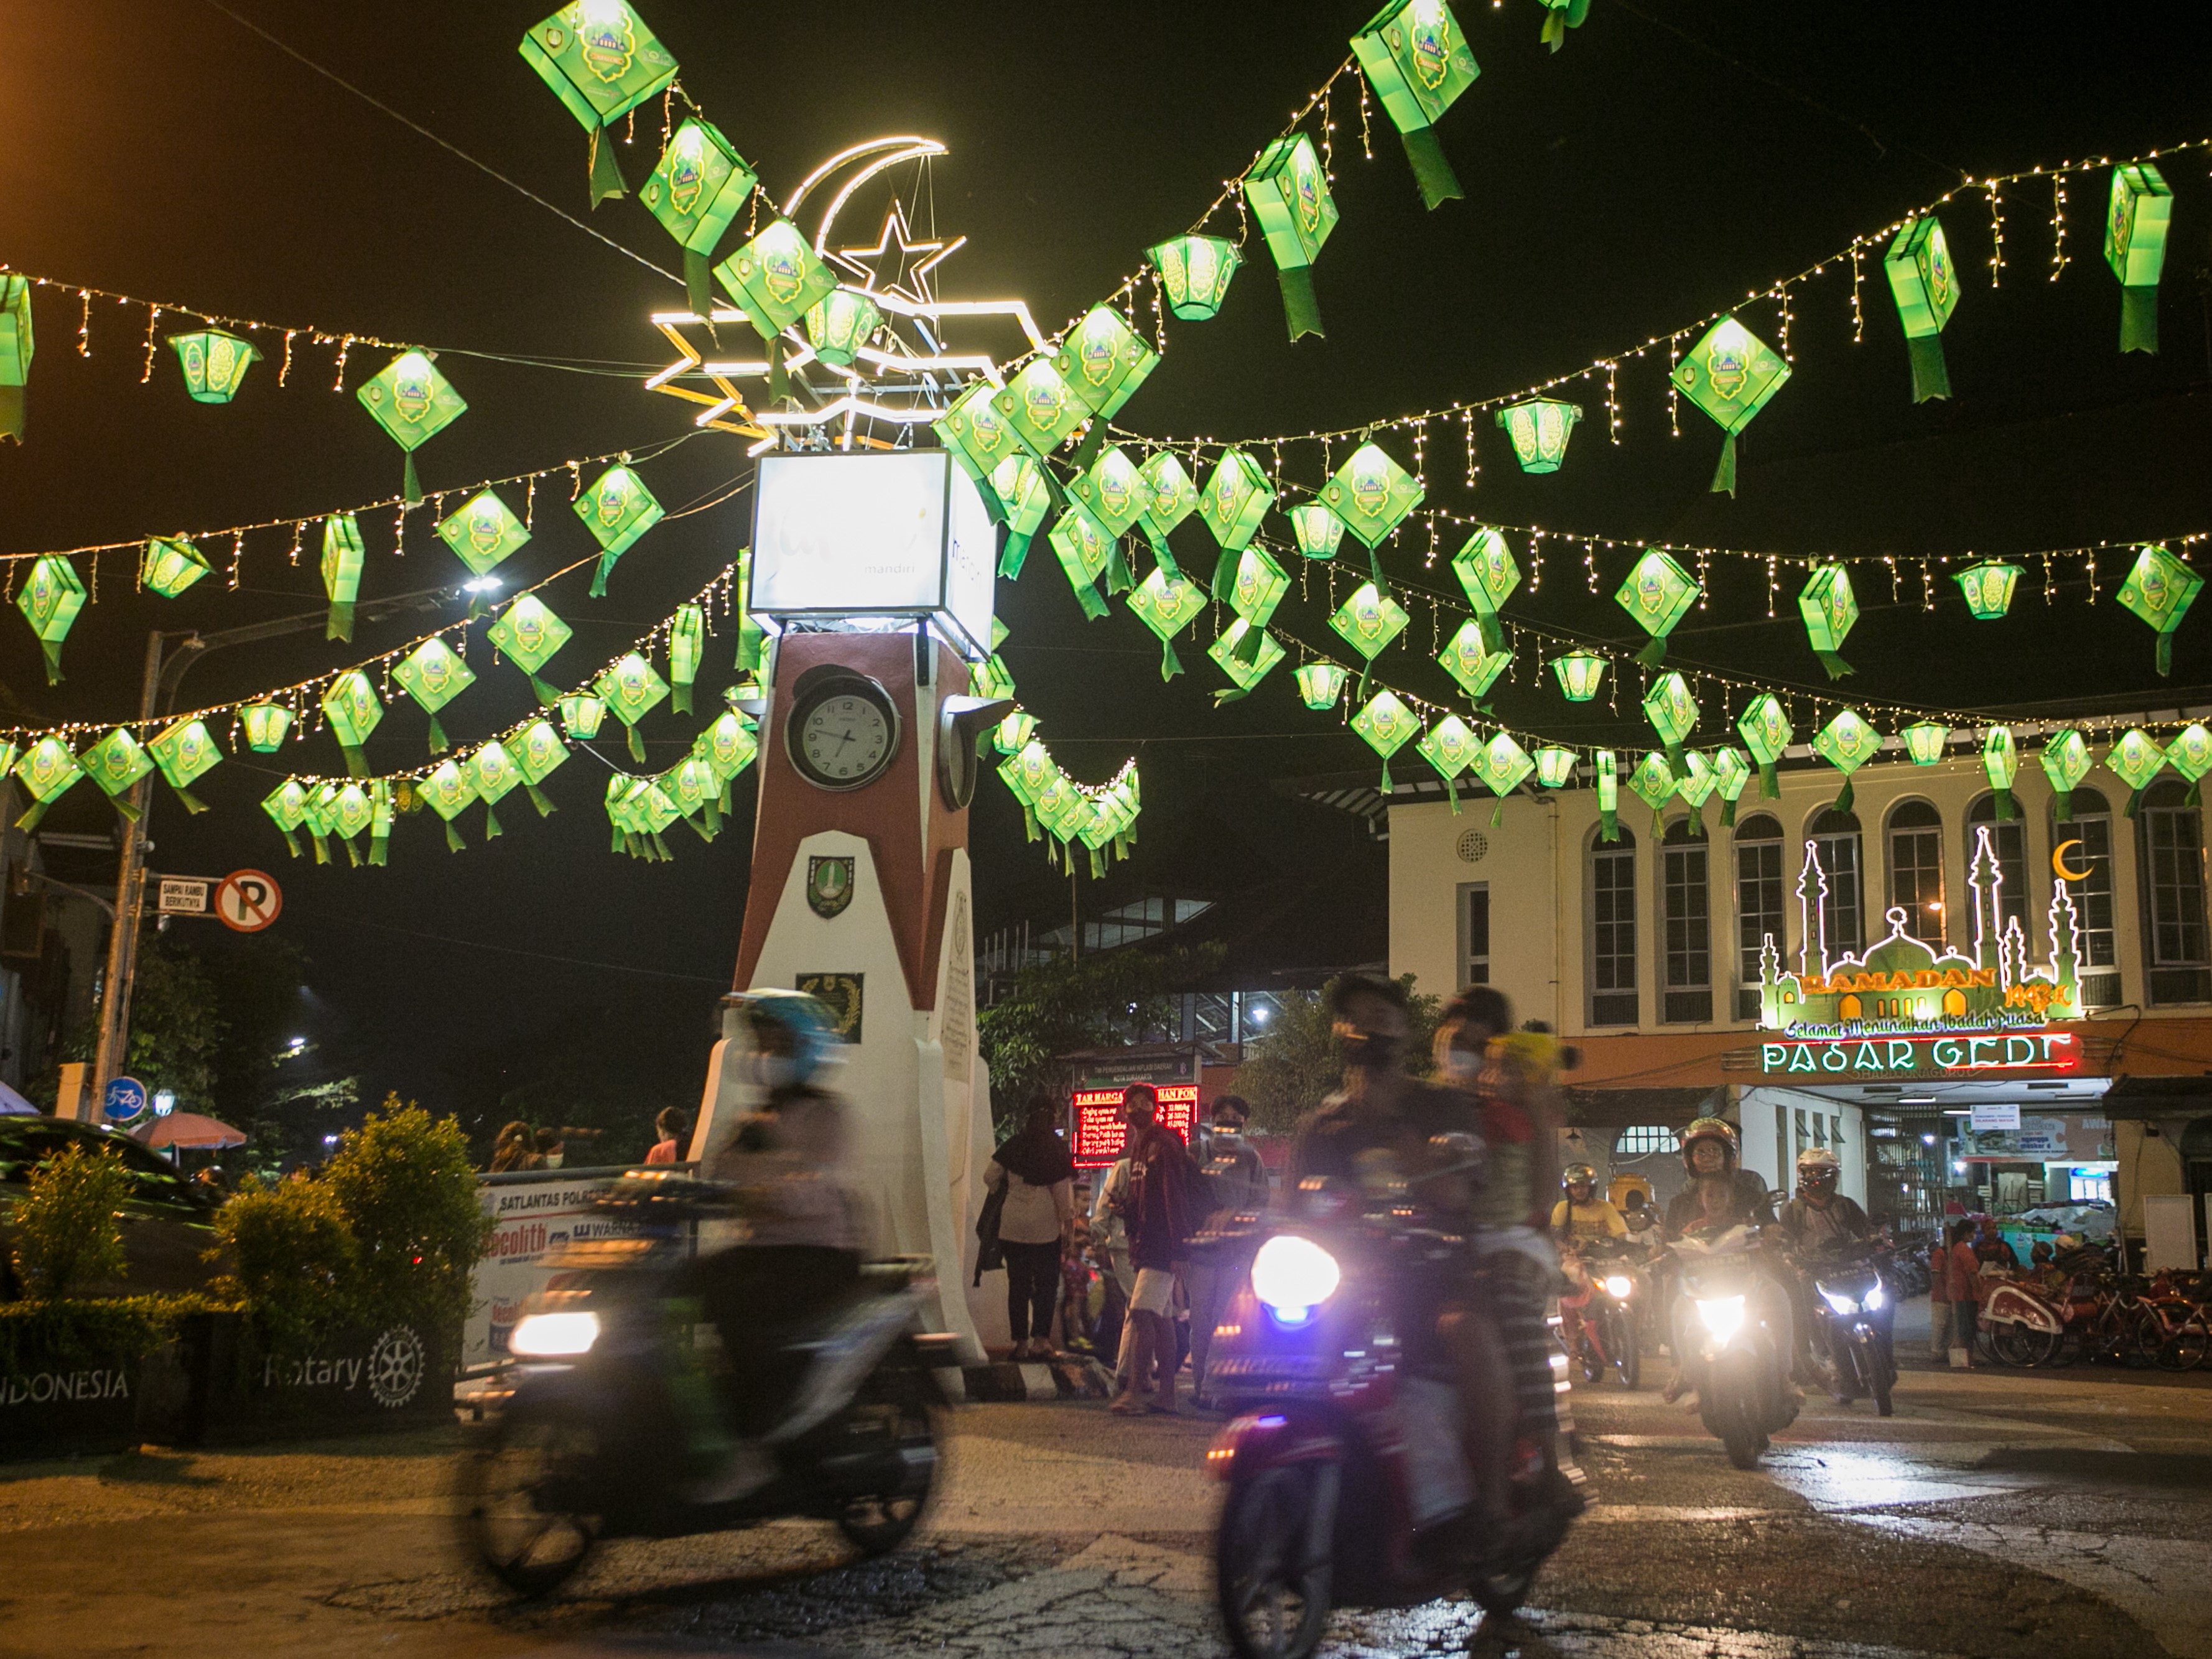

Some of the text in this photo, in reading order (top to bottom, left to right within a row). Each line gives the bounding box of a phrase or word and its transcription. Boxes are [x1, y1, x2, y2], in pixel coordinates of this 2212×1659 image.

[865, 563, 915, 574] mandiri
[827, 705, 835, 713] 11
[843, 702, 853, 710] 12
[813, 717, 824, 725] 10
[872, 718, 880, 727] 2
[809, 733, 817, 741] 9
[875, 735, 883, 744] 3
[812, 749, 820, 758] 8
[868, 751, 876, 759] 4
[822, 762, 831, 771] 7
[839, 767, 848, 775] 6
[857, 763, 865, 771] 5
[165, 896, 200, 908] BERIKUTNYA
[238, 881, 267, 921] P
[1800, 968, 1996, 994] RAMADAN
[2004, 984, 2051, 1008] 1443
[1784, 1016, 1844, 1038] Selamat
[1844, 1011, 1940, 1036] Menunaikan
[1940, 1009, 1991, 1032] Ibadah
[1763, 1039, 1914, 1073] PASAR
[1095, 1092, 1123, 1102] HARGA
[500, 1192, 559, 1211] SATLANTAS
[483, 1223, 546, 1257] ecolith
